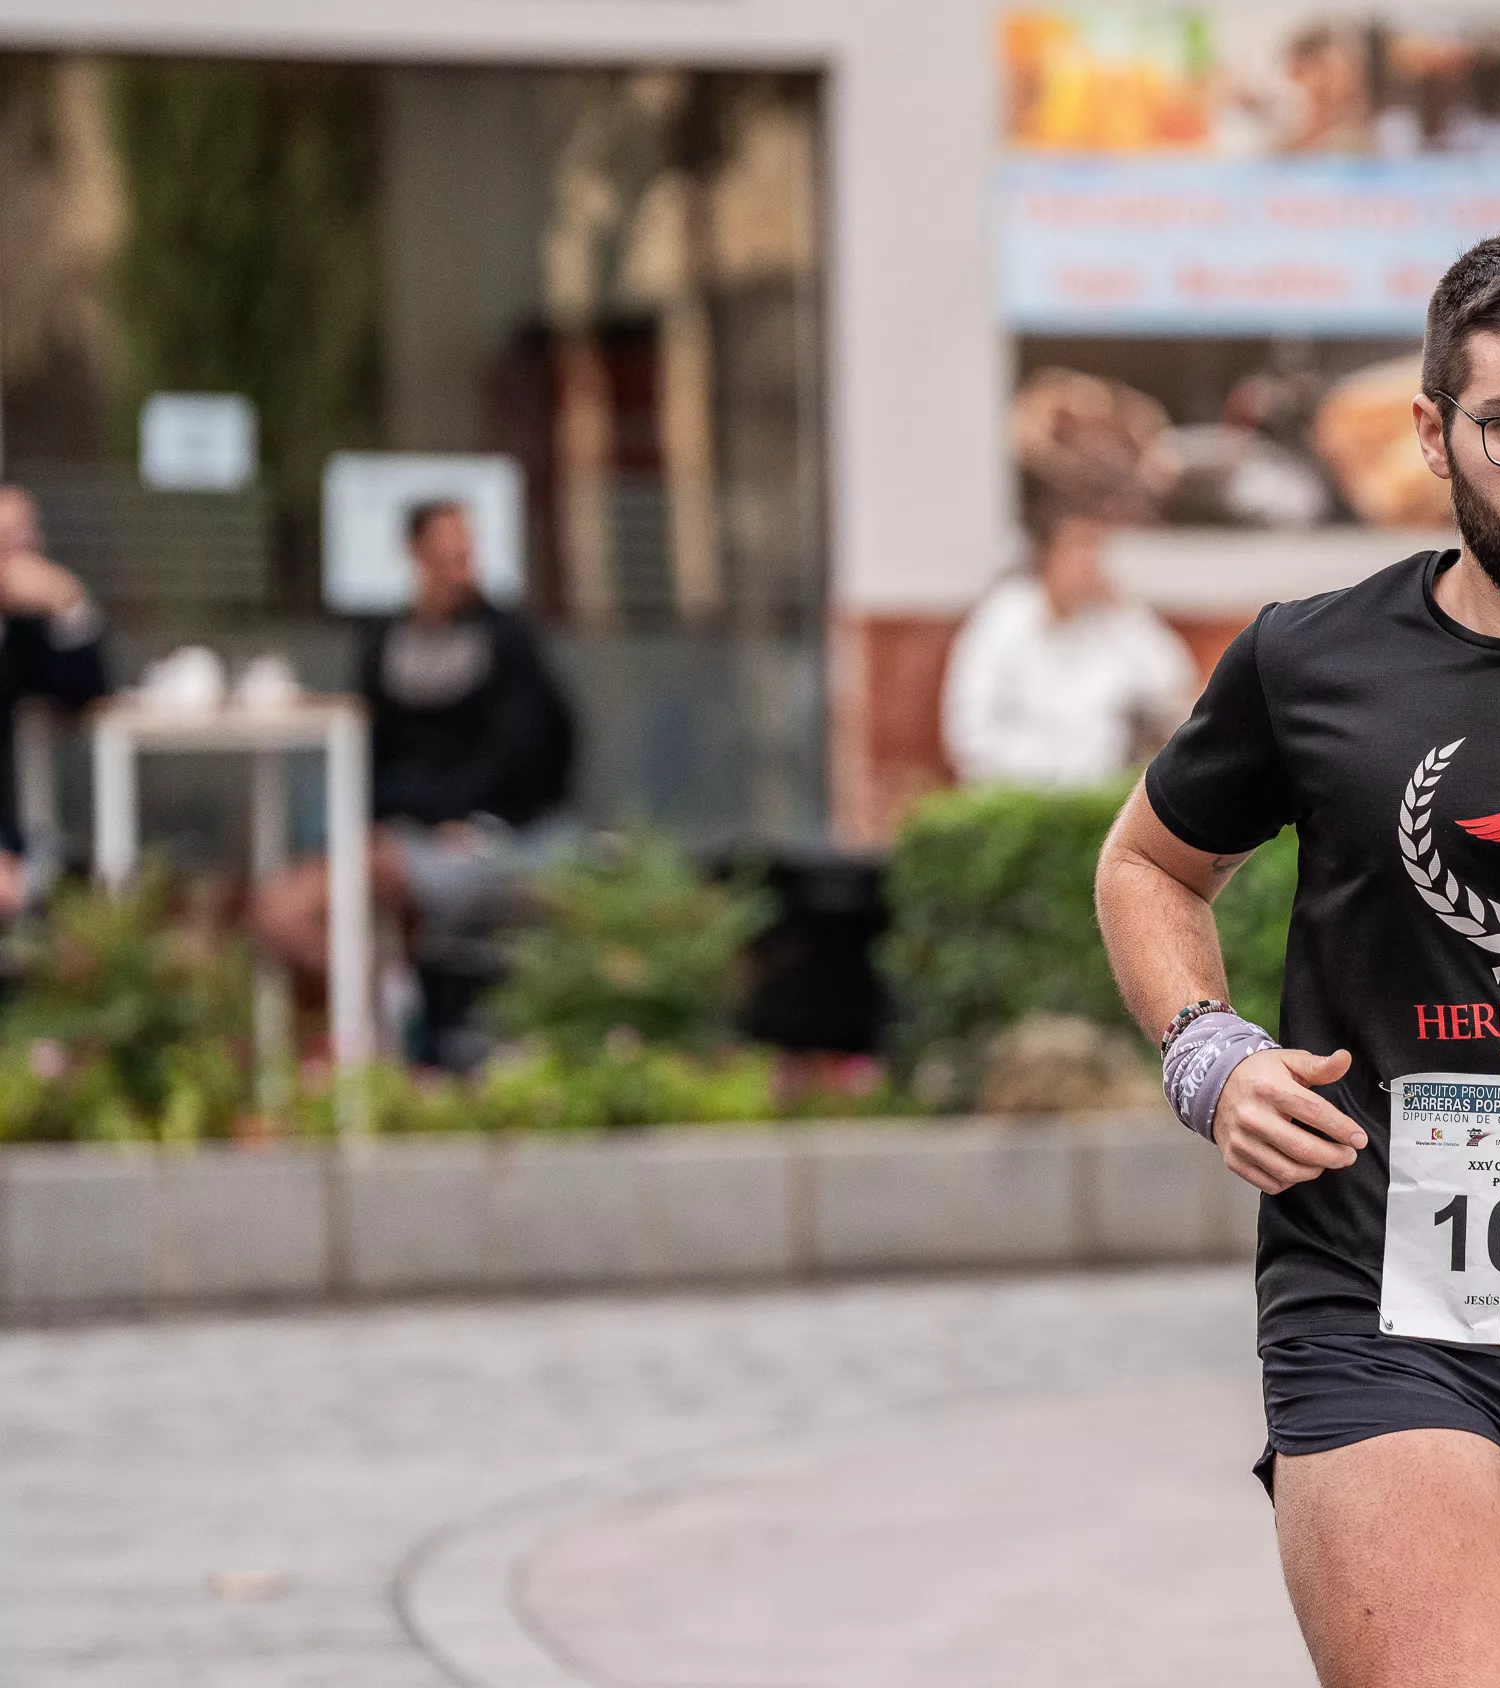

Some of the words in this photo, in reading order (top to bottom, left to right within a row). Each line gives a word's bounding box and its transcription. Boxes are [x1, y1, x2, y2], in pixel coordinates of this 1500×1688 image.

[1403, 1084, 1457, 1098] CIRCUITO
[1403, 1097, 1471, 1111] CARRERAS
[1403, 1111, 1469, 1123] DIPUTACIÓN
[1476, 1114, 1490, 1124] DE
[1468, 1160, 1493, 1171] XXV
[1464, 1294, 1500, 1306] JESÚS
